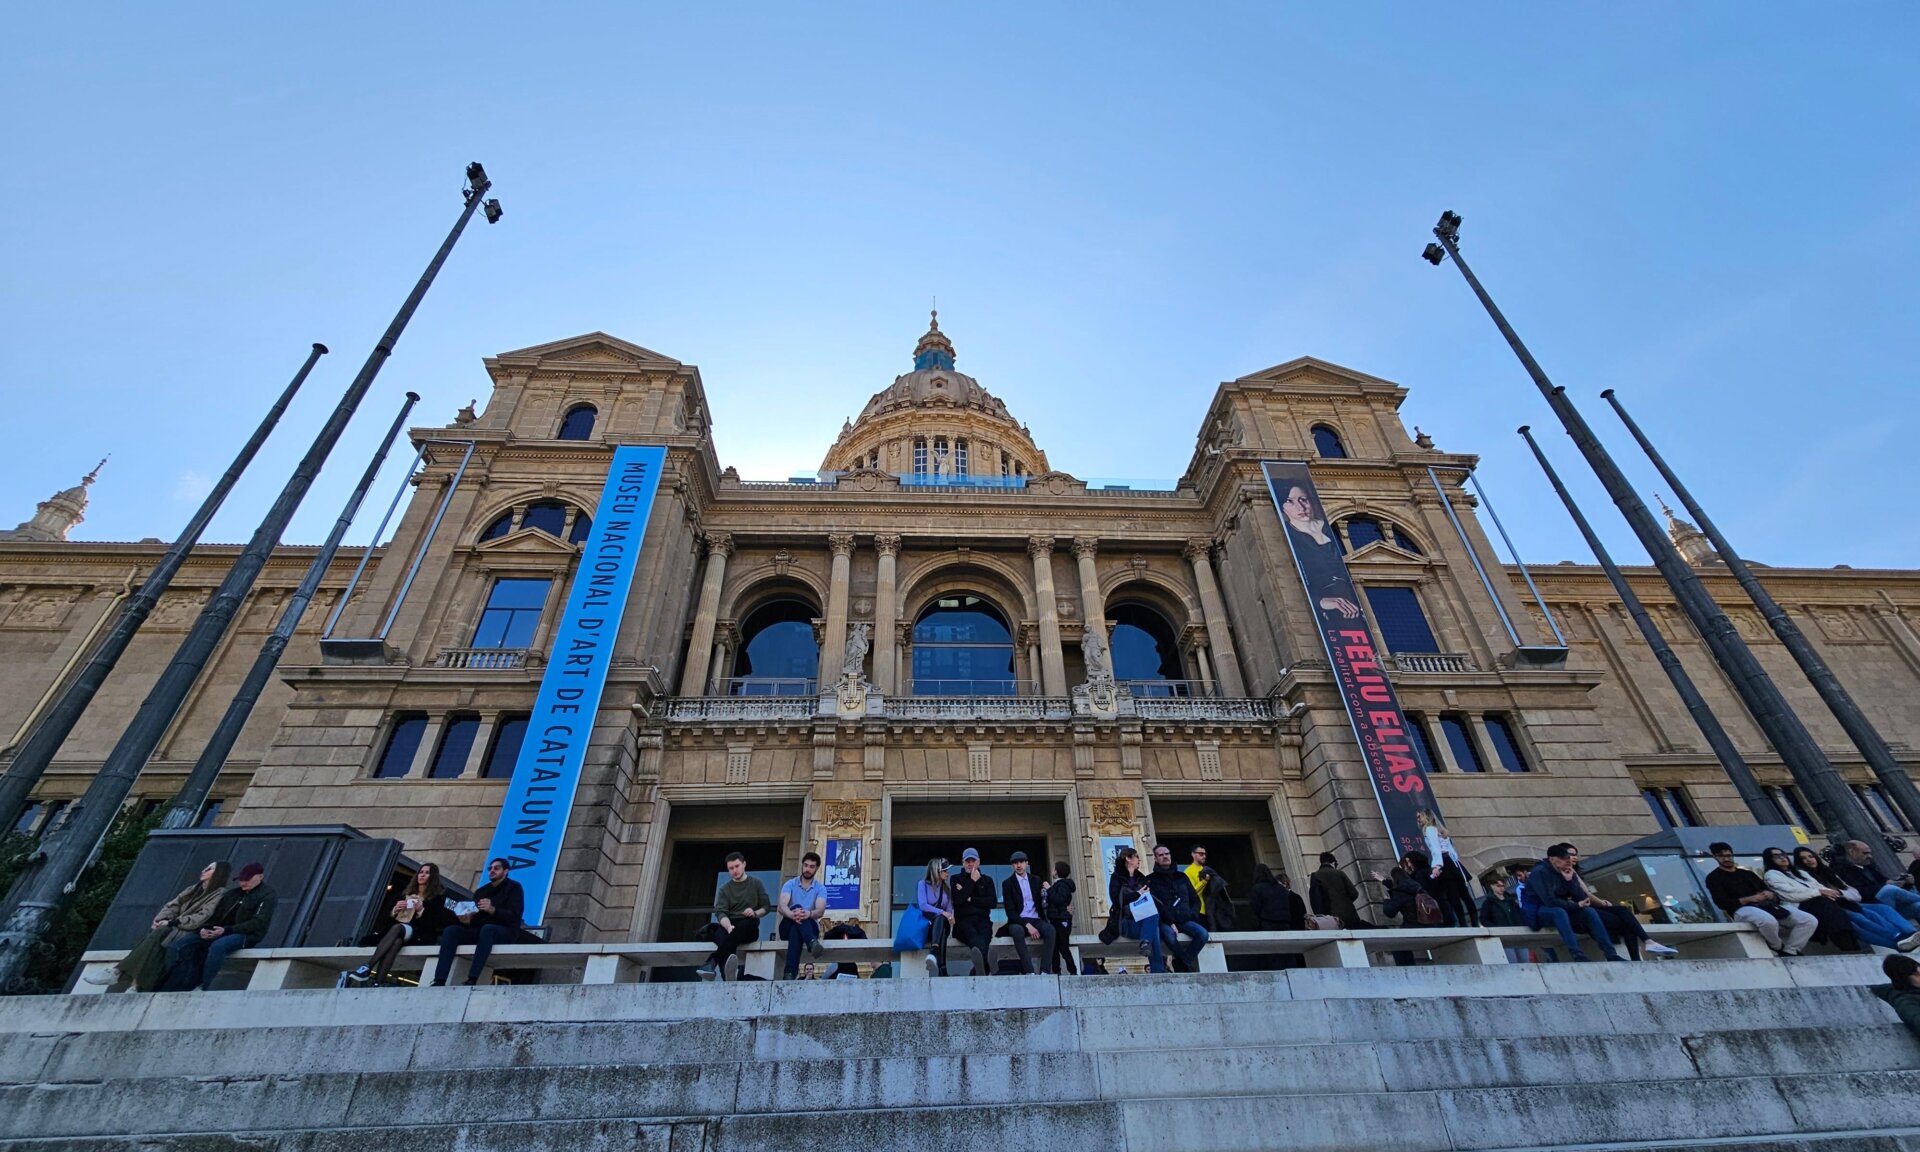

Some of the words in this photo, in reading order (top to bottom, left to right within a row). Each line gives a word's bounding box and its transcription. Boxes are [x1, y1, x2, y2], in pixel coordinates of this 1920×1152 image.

[612, 462, 648, 513] MUSEU
[582, 521, 631, 609] NACIONAL
[562, 618, 604, 678] D'ART
[1327, 629, 1337, 642] La
[1333, 646, 1355, 689] realitat
[551, 688, 584, 715] DE
[1339, 630, 1391, 702] FELIU
[1368, 711, 1424, 793] ELIAS
[1350, 693, 1364, 718] com
[1360, 722, 1369, 730] a
[1364, 734, 1393, 793] obsessió
[507, 726, 573, 870] CATALUNYA
